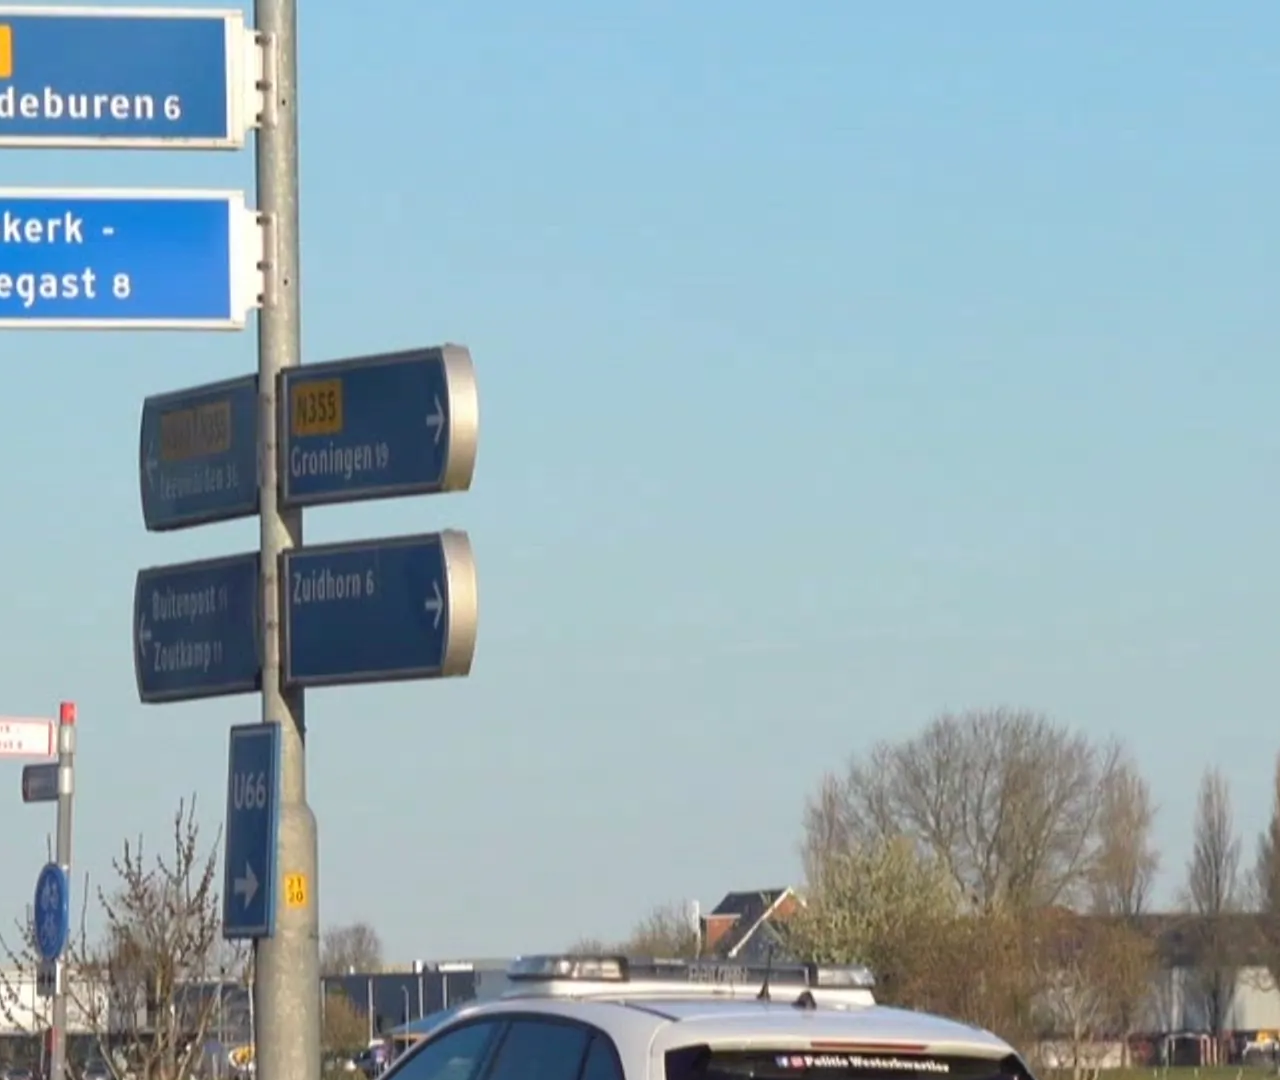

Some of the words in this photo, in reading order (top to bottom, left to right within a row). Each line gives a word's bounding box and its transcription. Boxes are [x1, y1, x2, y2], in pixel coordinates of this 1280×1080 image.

[164, 95, 181, 120] 6
[112, 275, 132, 299] 8
[296, 390, 337, 425] N355
[291, 443, 372, 478] Groningen
[292, 570, 362, 604] Zuidhorn
[365, 571, 375, 596] 6
[153, 638, 212, 674] Zoutkamp
[233, 772, 267, 810] U66
